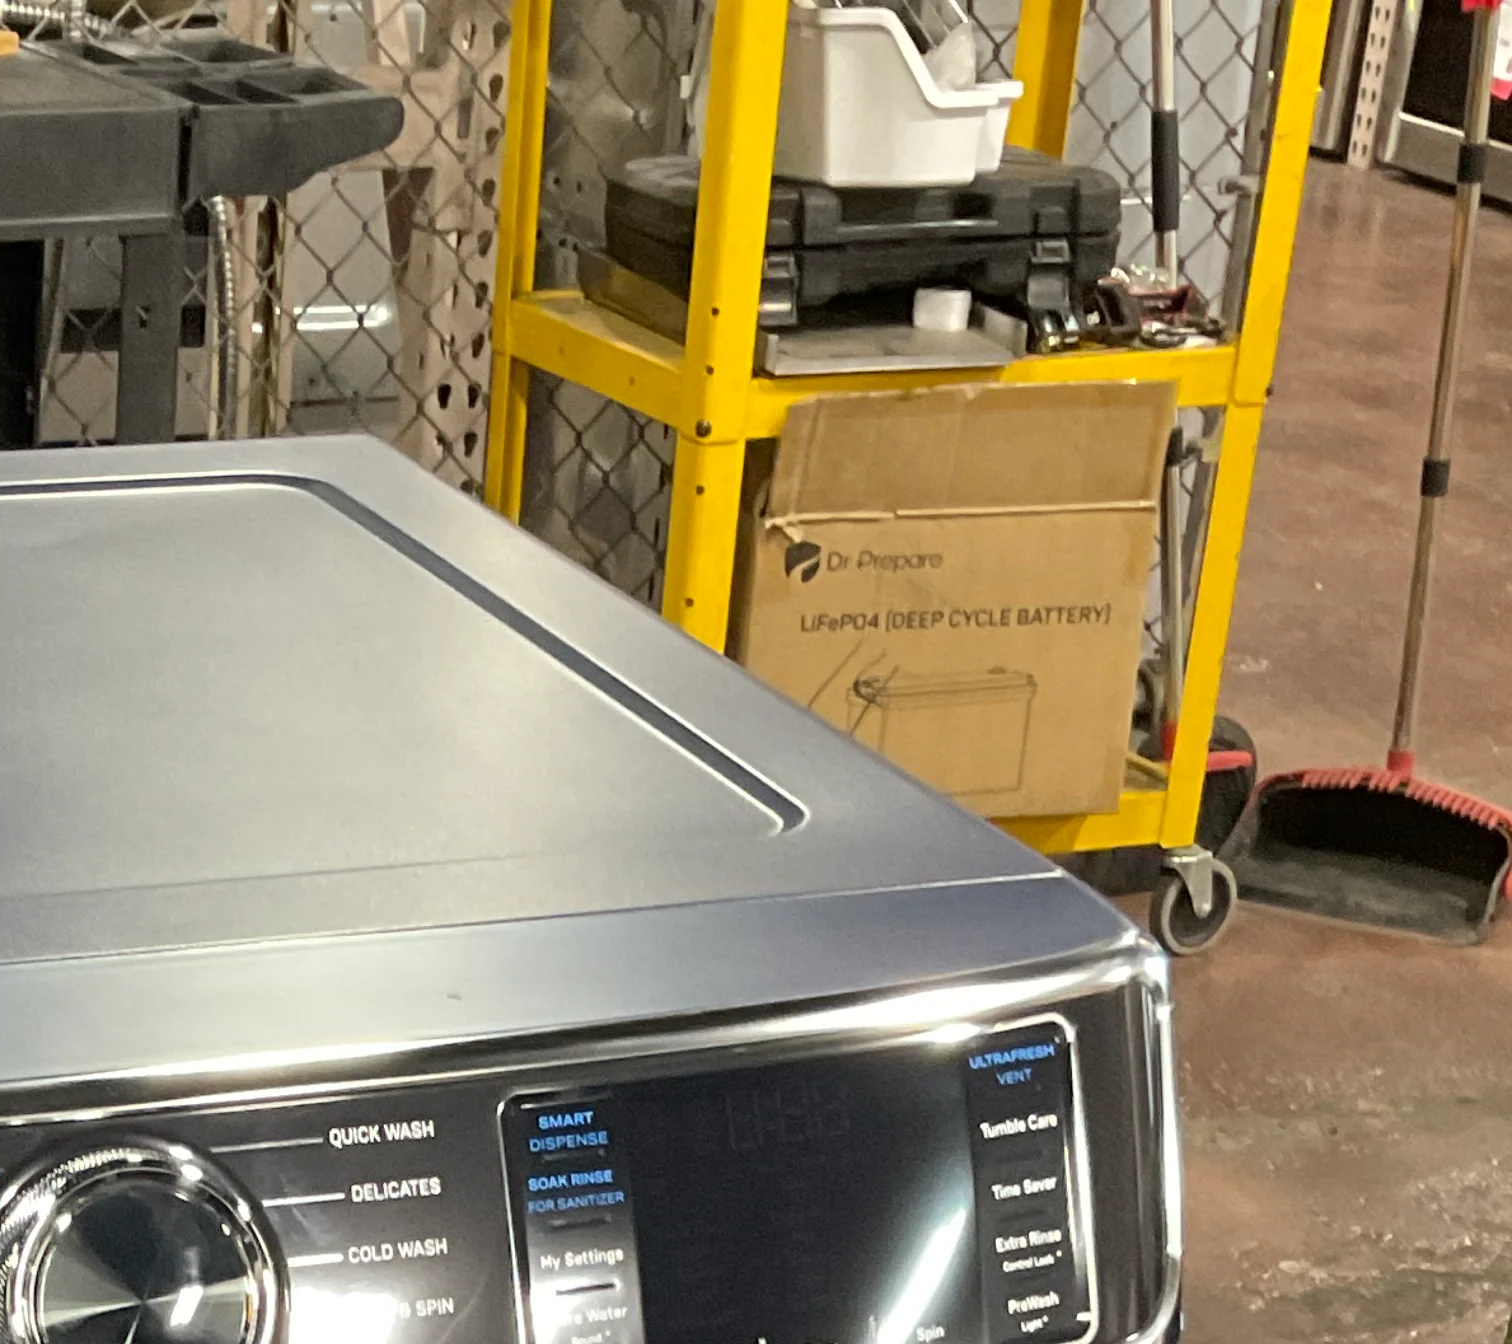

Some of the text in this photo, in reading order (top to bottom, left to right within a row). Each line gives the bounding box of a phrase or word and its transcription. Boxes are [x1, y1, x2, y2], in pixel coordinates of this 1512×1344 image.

[827, 550, 944, 573] Dr Prepare
[885, 610, 945, 633] (DEEP
[948, 607, 1012, 629] CYCLE
[1017, 602, 1111, 627] BATTERY)
[968, 1043, 1056, 1070] ULTRAFRESH
[995, 1067, 1033, 1085] VENT
[538, 1111, 594, 1130] SMART
[979, 1113, 1058, 1139] Tumble Care
[328, 1120, 435, 1149] QUICK WASH
[529, 1130, 609, 1152] DISPENSE
[350, 1176, 442, 1203] DELICATES
[528, 1169, 614, 1191] SOAK RINSE
[991, 1177, 1058, 1200] Time Saver
[528, 1190, 625, 1213] FOR SANITIZER
[348, 1238, 448, 1264] COLD WASH
[995, 1229, 1062, 1253] Extra Rinse
[540, 1248, 624, 1271] My Settings
[415, 1297, 454, 1317] SPIN
[586, 1306, 629, 1322] Water
[916, 1324, 946, 1344] Spin
